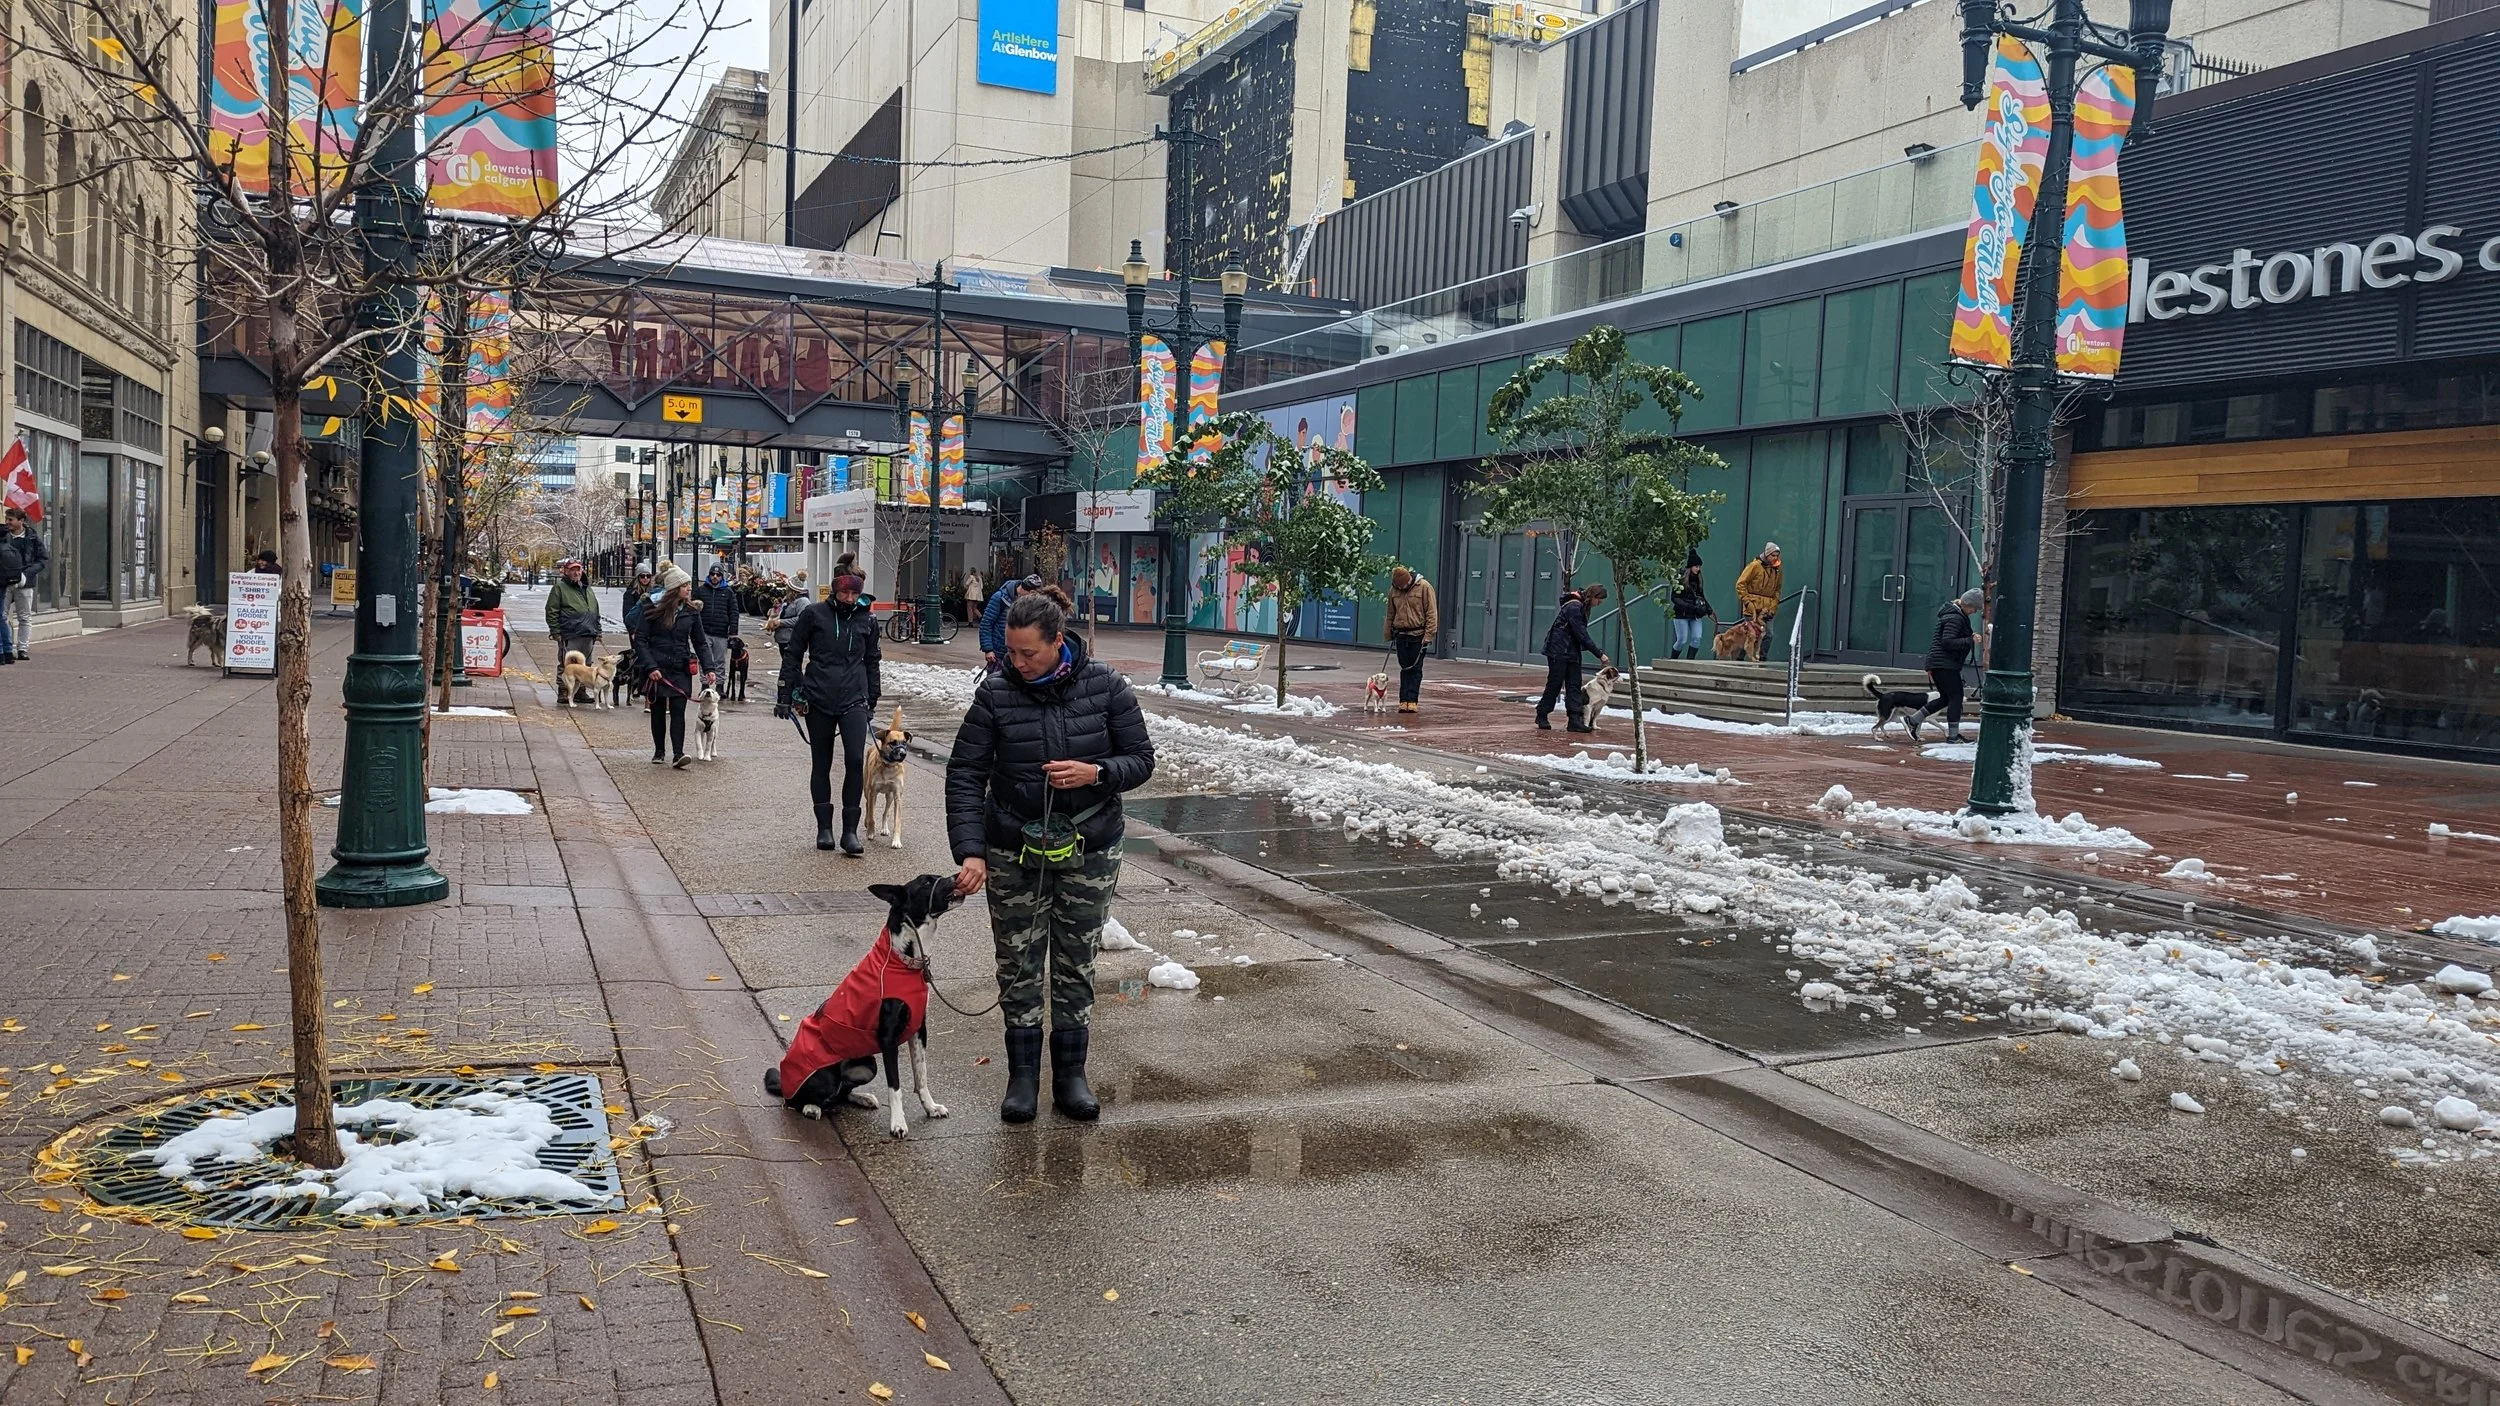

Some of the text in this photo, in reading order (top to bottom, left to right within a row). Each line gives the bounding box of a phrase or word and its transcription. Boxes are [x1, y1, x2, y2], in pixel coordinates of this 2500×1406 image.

[991, 29, 1050, 49] ArtIsHere
[991, 41, 1058, 63] AtGlenbow
[1997, 95, 2025, 205] Stephen
[484, 161, 543, 177] downtown
[484, 174, 528, 188] calgary
[1991, 176, 2013, 275] Avenue
[1977, 229, 1998, 312] Walk
[2128, 224, 2464, 324] lestones
[667, 399, 698, 409] 5.0 m
[1083, 505, 1114, 519] cagary
